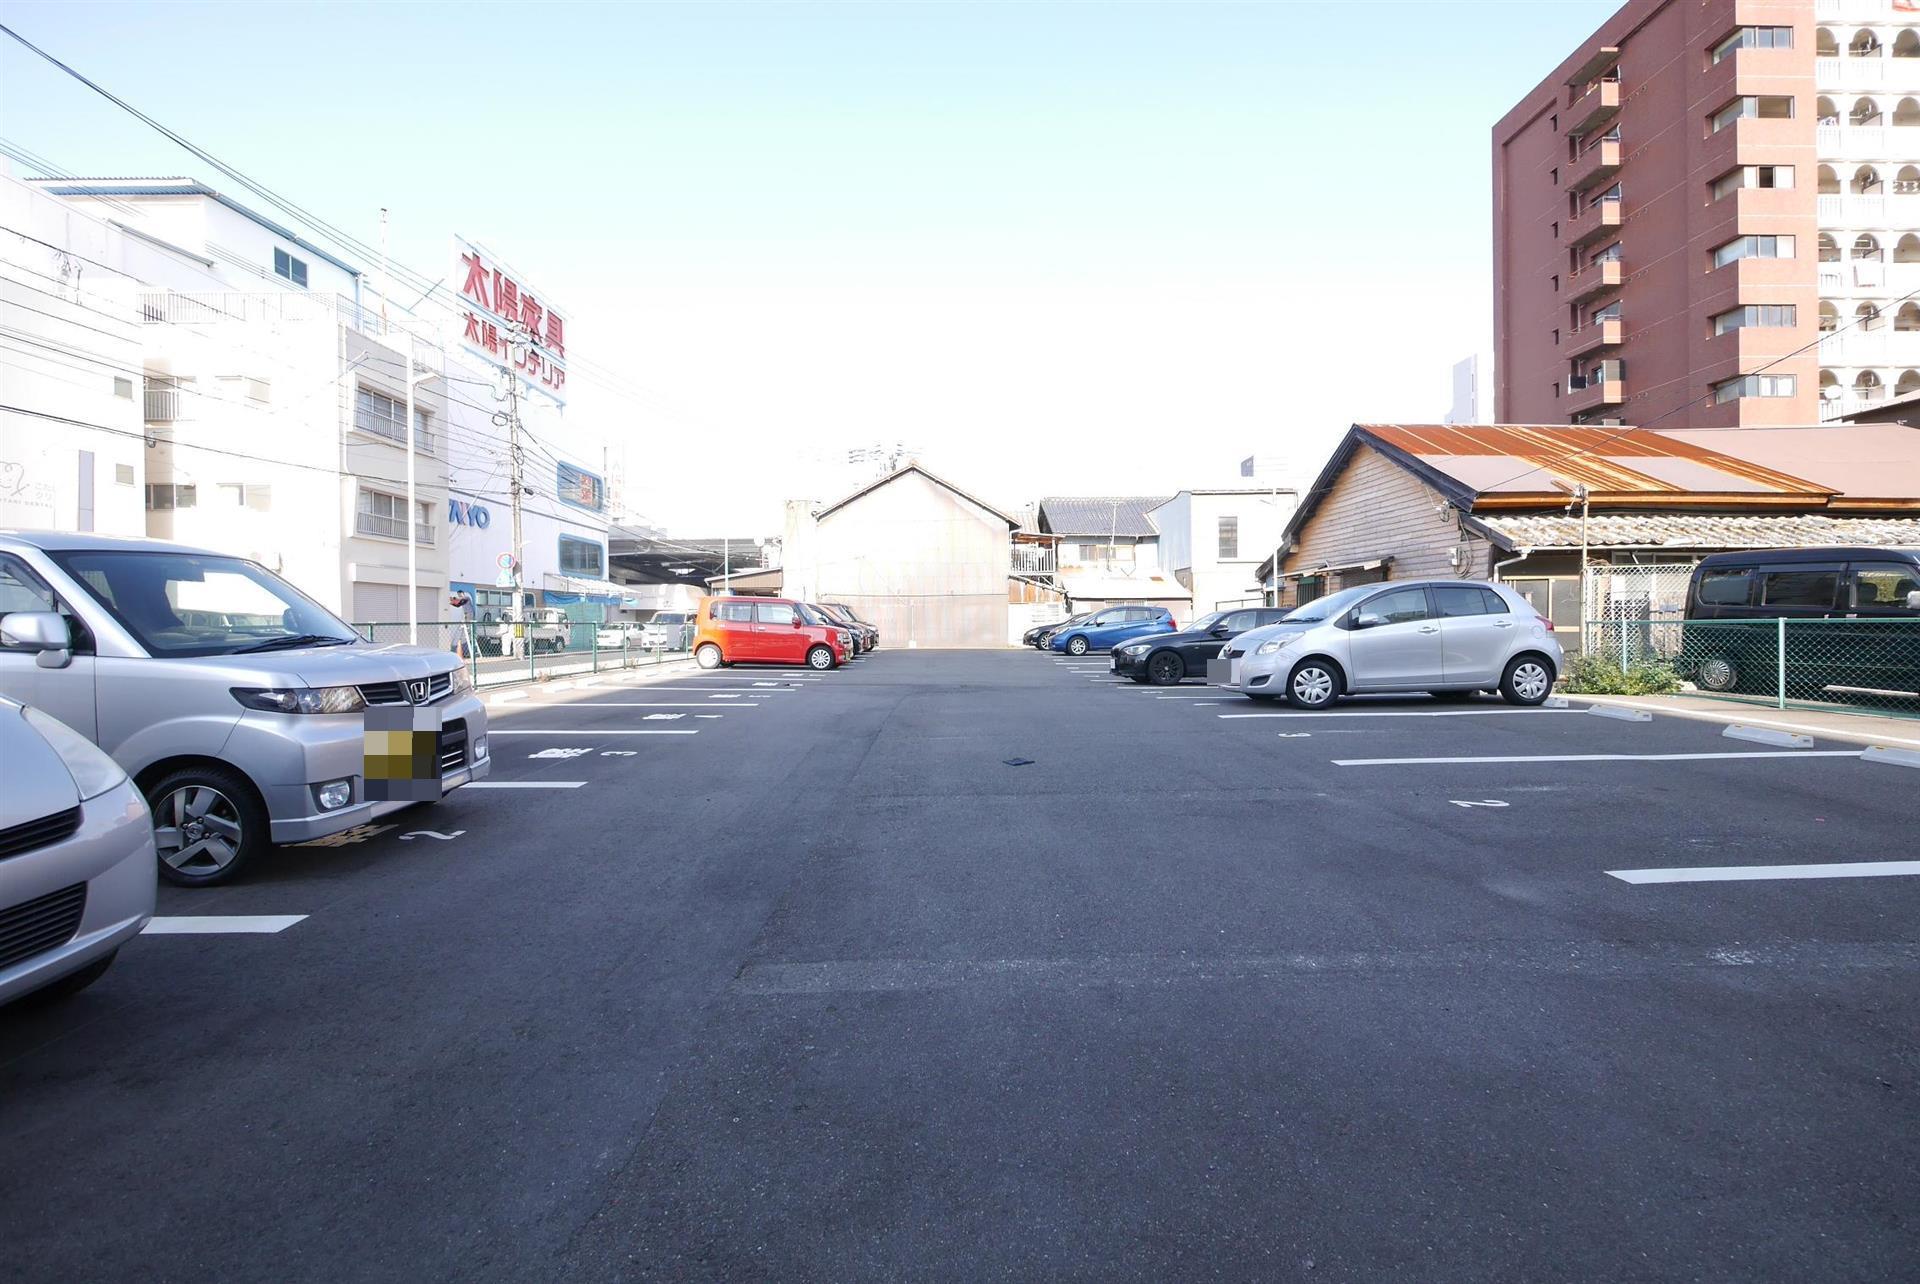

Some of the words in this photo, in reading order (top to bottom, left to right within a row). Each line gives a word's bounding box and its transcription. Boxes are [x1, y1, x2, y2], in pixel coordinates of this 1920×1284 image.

[462, 251, 565, 359] 太陽家具
[463, 311, 566, 390] 太陽インテリア
[1449, 799, 1510, 808] 2
